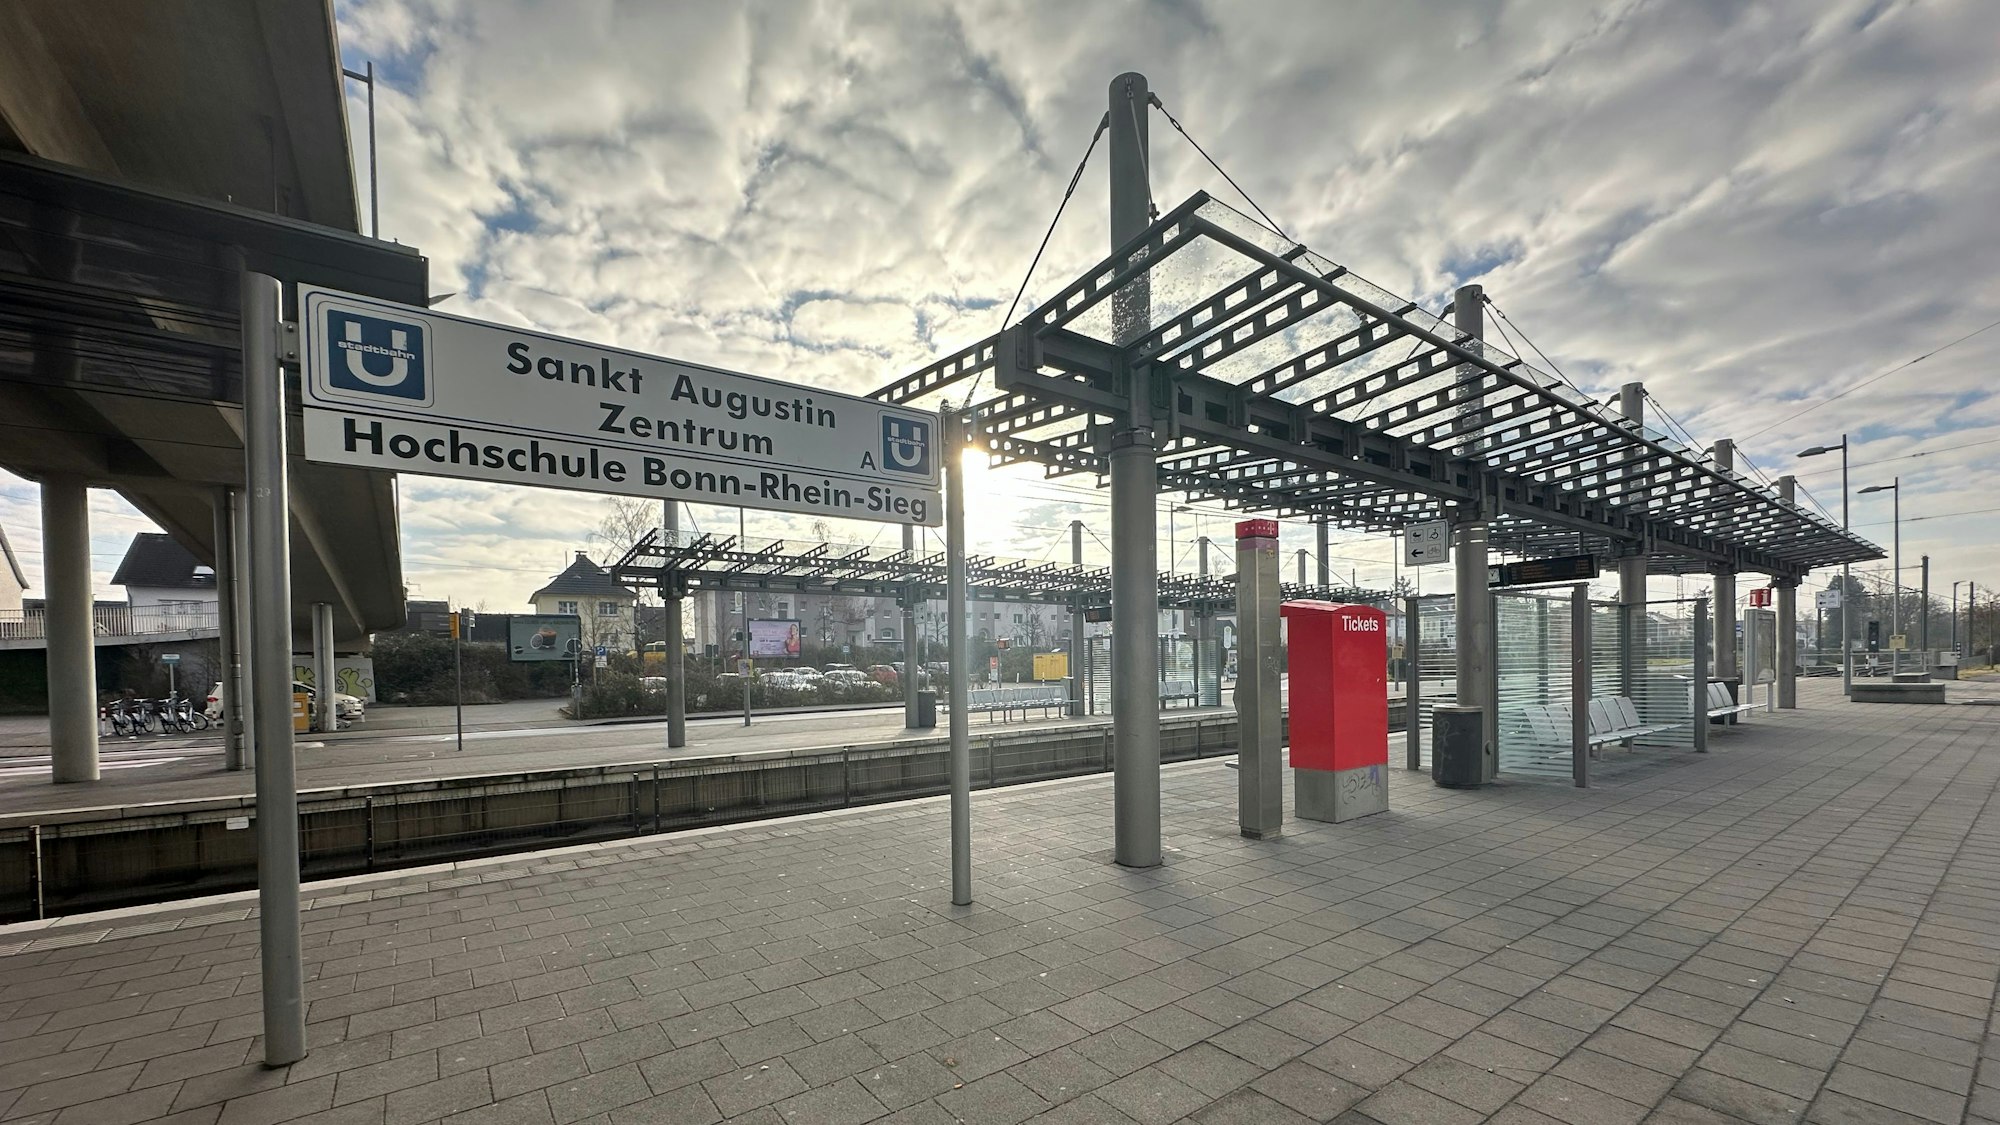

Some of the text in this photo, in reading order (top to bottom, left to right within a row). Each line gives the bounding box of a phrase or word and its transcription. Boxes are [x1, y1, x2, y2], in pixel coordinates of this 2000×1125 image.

[338, 341, 415, 360] stadtbahn
[507, 342, 836, 429] Sankt Augustin
[598, 402, 774, 456] Zentrum
[887, 436, 925, 448] stadtbahn
[344, 417, 927, 522] Hochschule Bonn-Rhein-Sieg
[860, 451, 876, 471] A
[1341, 615, 1379, 631] Tickets
